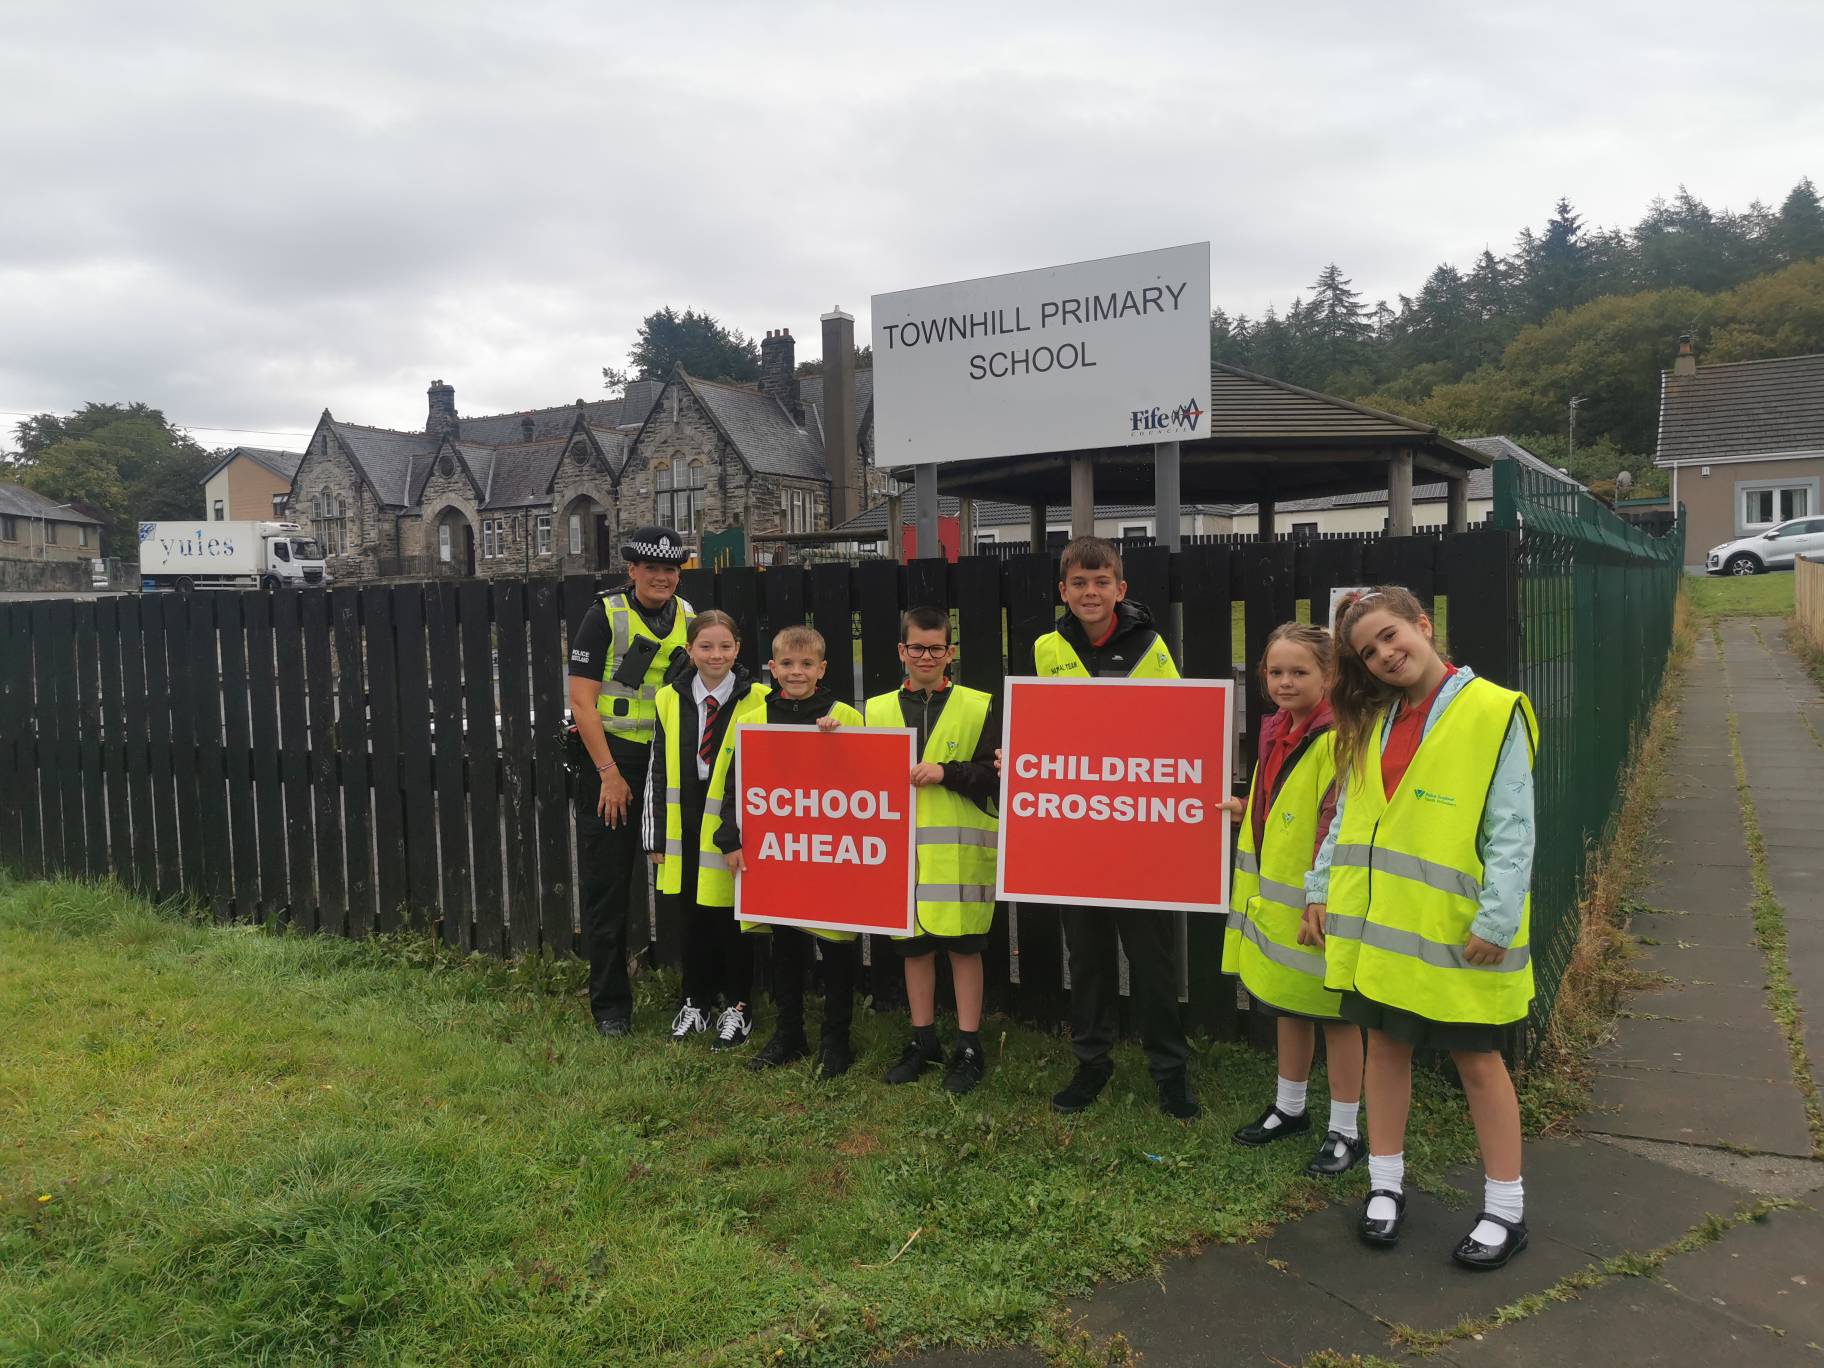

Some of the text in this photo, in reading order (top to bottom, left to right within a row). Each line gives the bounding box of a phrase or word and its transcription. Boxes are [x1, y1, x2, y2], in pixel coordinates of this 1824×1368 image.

[883, 282, 1188, 349] TOWNHILL PRIMARY
[969, 341, 1097, 380] SCHOOL
[1130, 406, 1169, 431] Fife
[572, 649, 590, 657] POLICE
[1015, 753, 1202, 784] CHILDREN
[746, 787, 900, 820] SCHOOL
[1012, 792, 1204, 824] CROSSING
[758, 832, 887, 865] AHEAD
